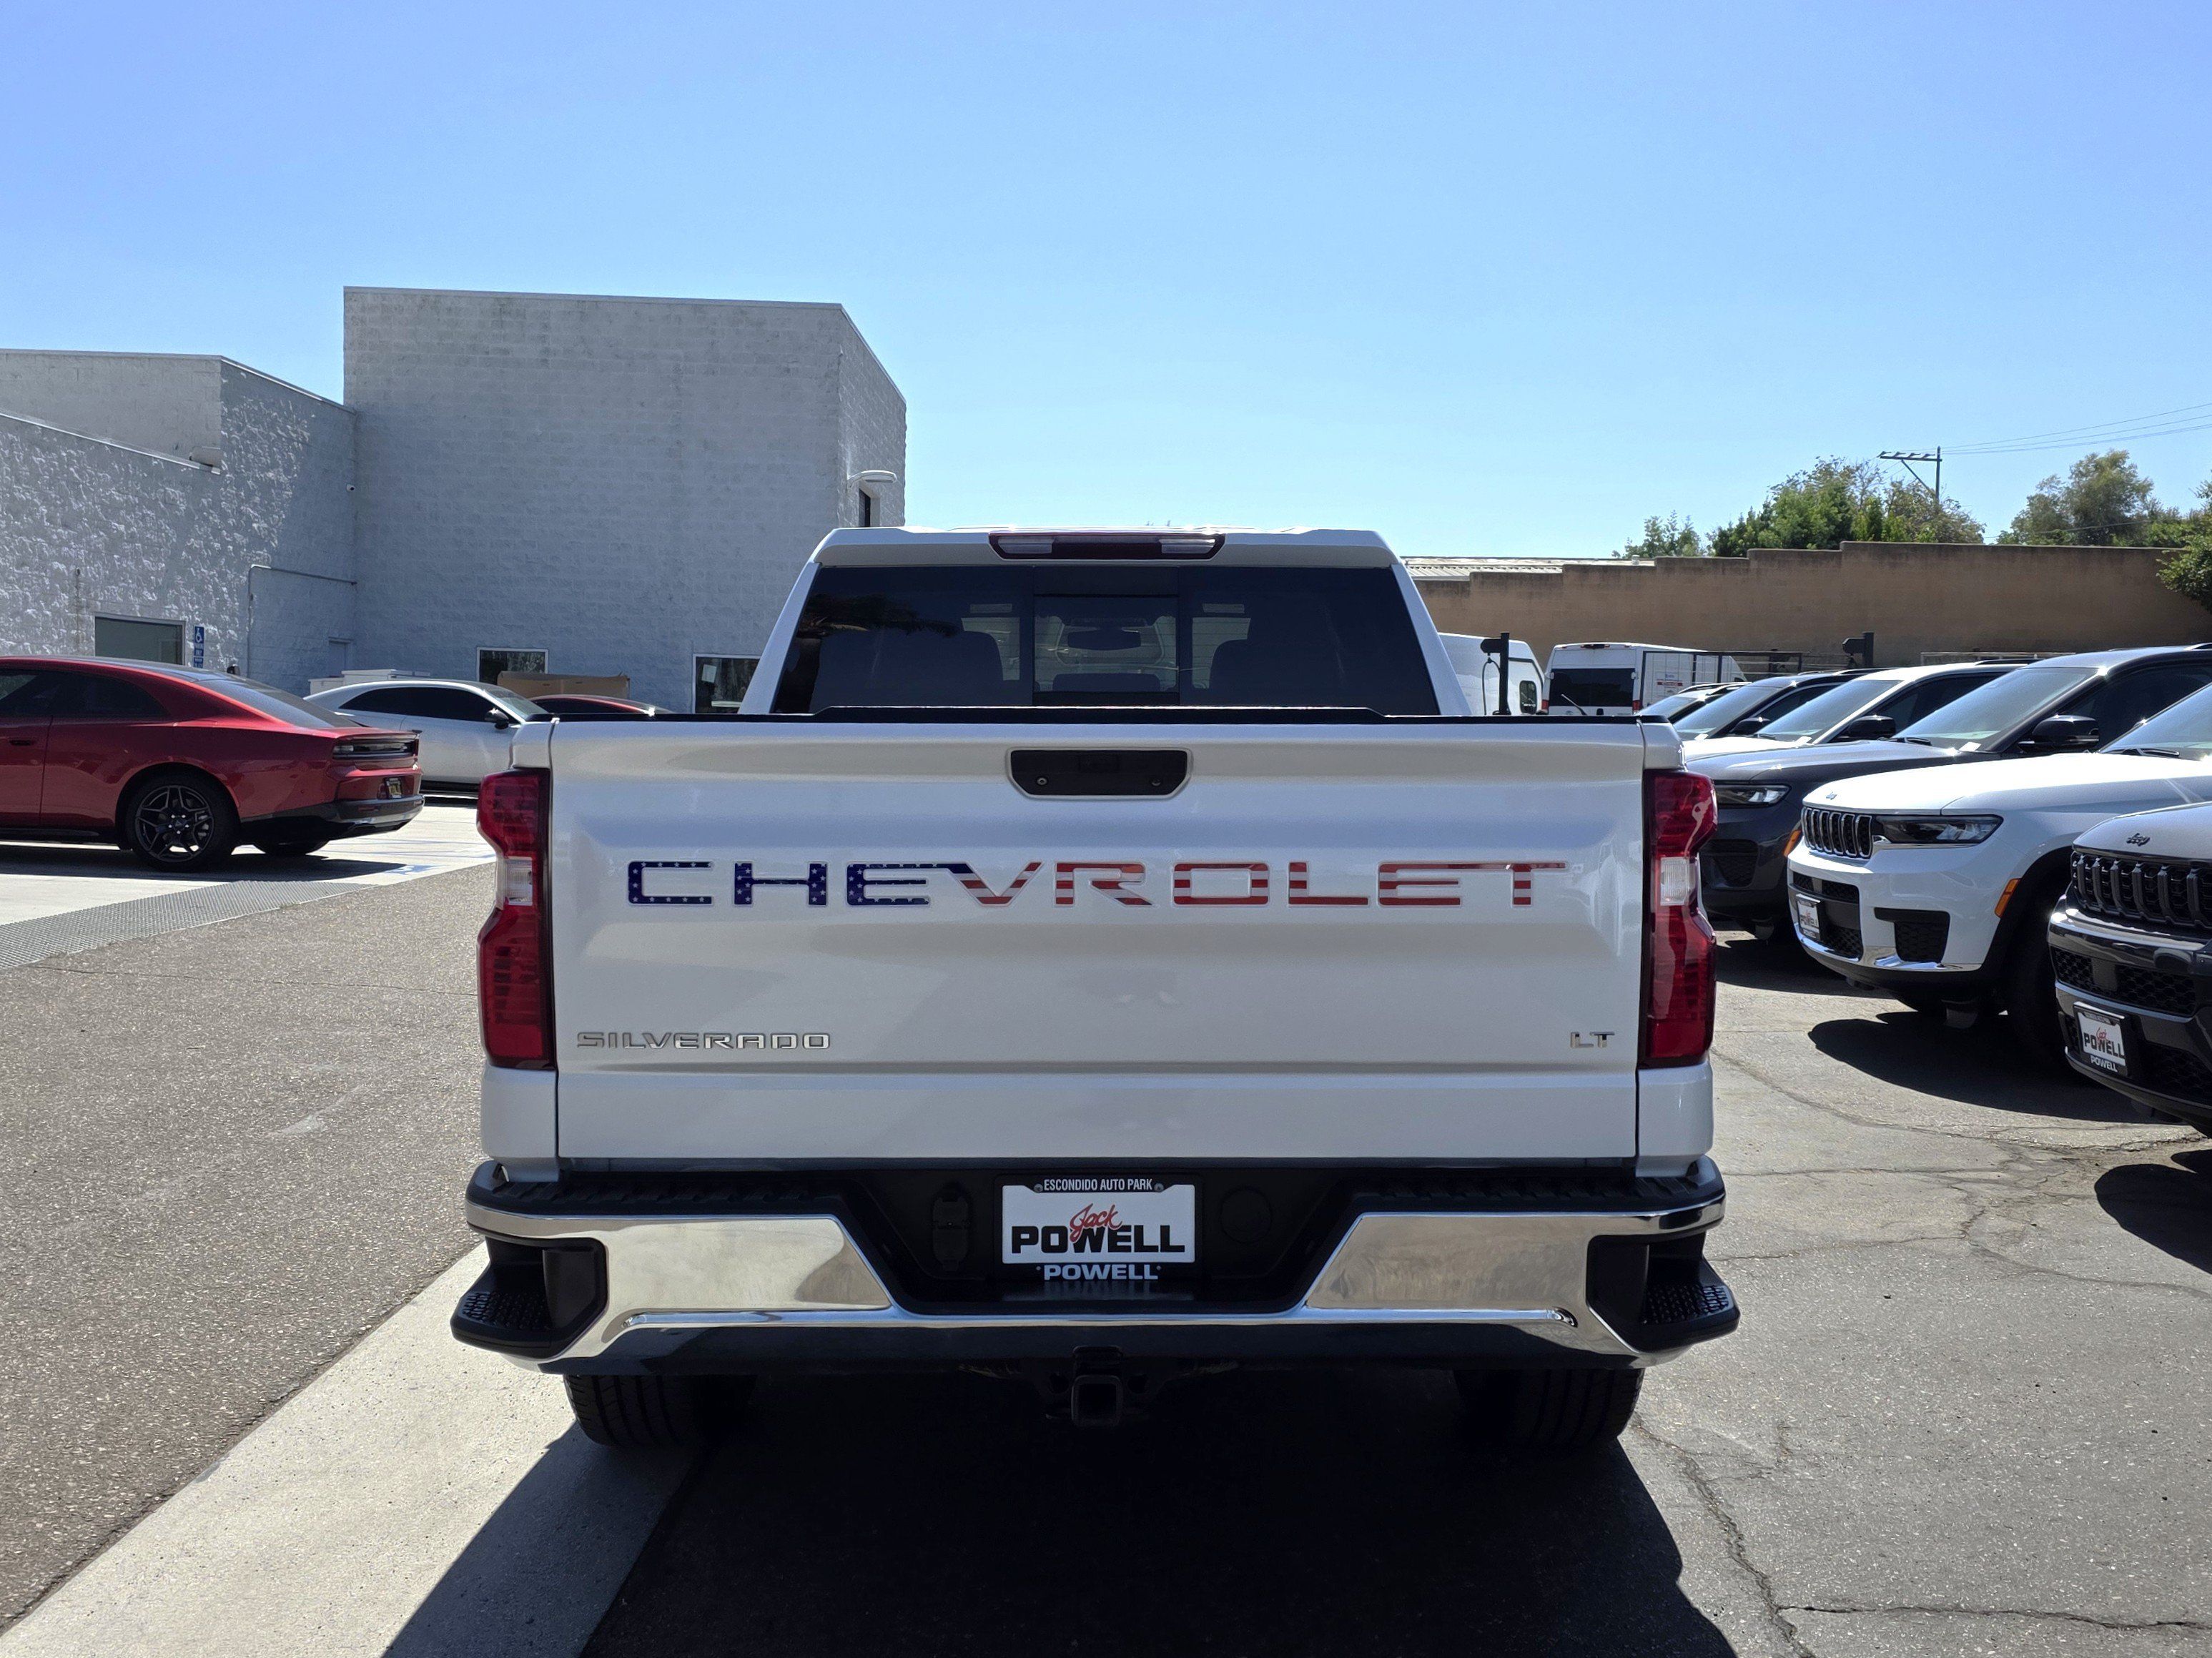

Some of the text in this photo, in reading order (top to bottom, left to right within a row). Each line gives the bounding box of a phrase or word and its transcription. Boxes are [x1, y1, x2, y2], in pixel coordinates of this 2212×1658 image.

[628, 860, 1567, 907] CHEVROLET
[576, 1032, 831, 1050] SILVERADO
[1570, 1032, 1615, 1048] LT
[2084, 1033, 2125, 1057] POWELL
[2090, 1055, 2118, 1072] POWELL
[1044, 1179, 1152, 1191] ESCONDIDO AUTO PARK
[1070, 1203, 1123, 1243] Jack
[1012, 1225, 1185, 1253] POWELL
[1044, 1265, 1158, 1280] POWELL
